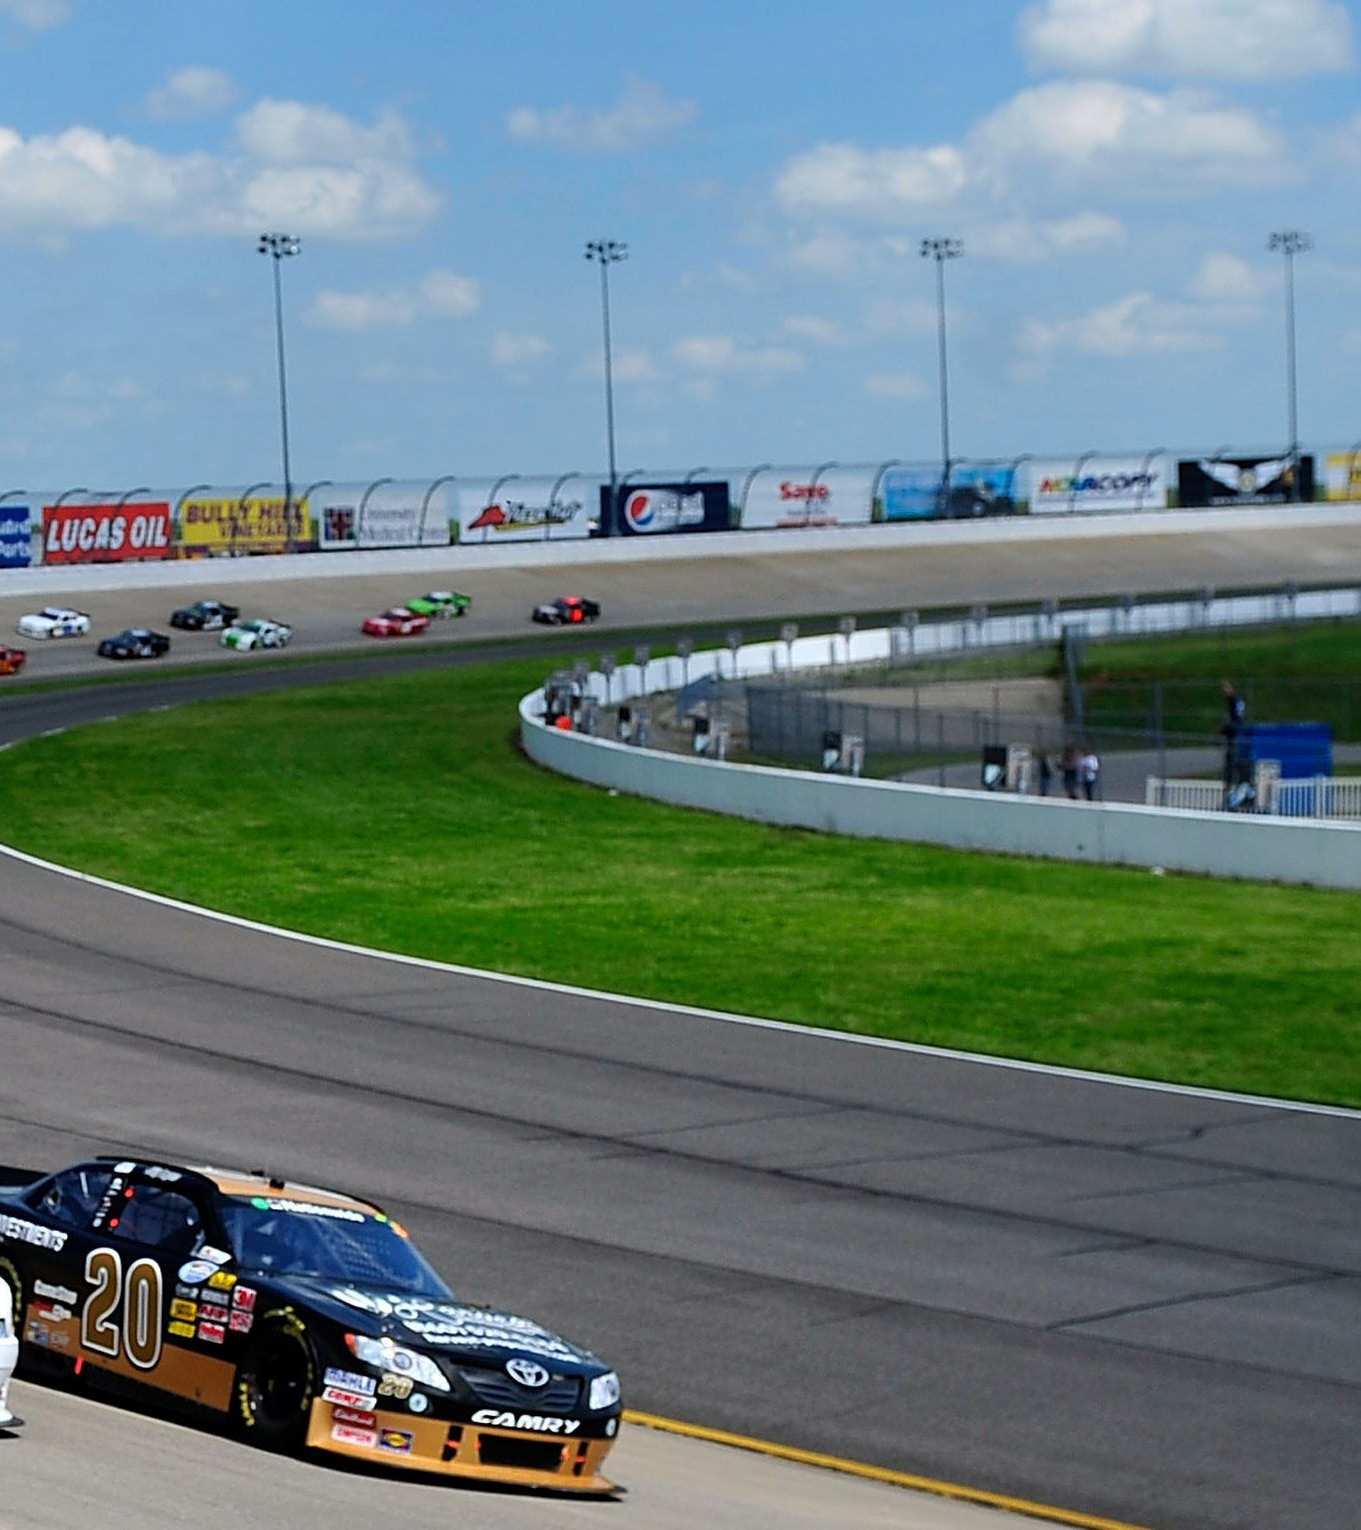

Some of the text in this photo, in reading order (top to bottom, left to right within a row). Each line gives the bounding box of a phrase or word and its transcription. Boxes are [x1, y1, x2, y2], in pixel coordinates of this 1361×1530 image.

[46, 514, 168, 553] LUCAS OIL
[280, 1199, 365, 1223] Nationwide
[81, 1247, 164, 1369] 20
[377, 1372, 415, 1400] 20
[471, 1408, 582, 1435] CAMRY
